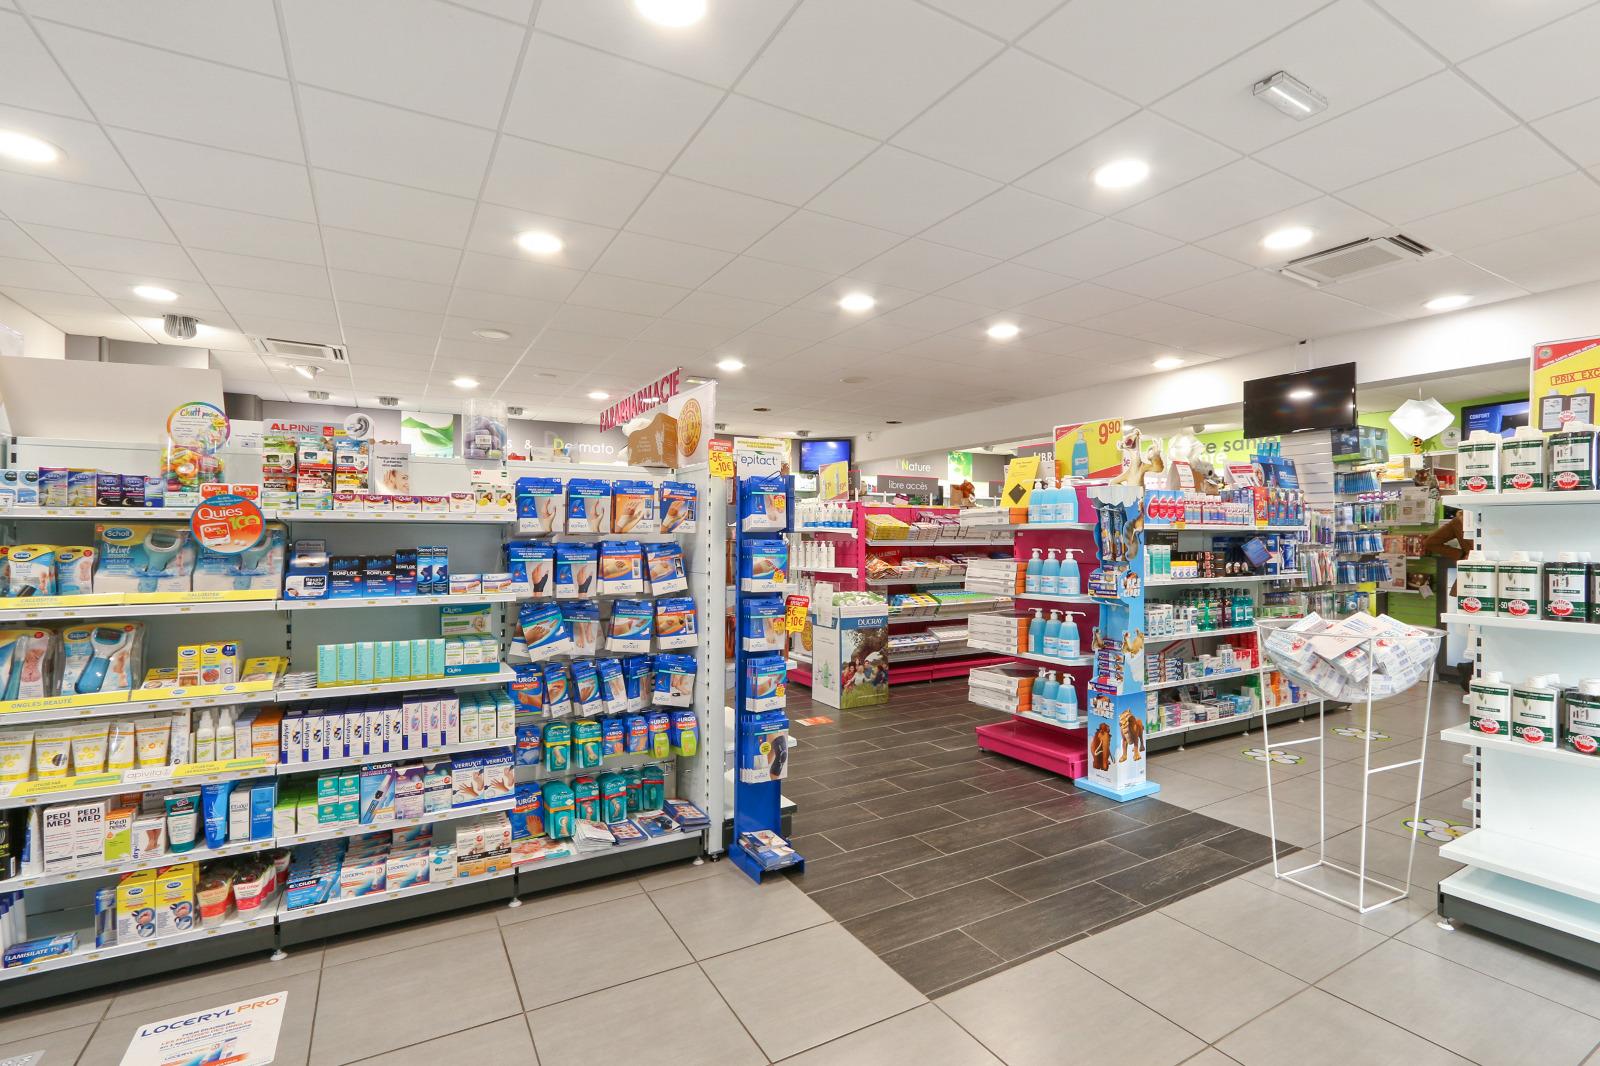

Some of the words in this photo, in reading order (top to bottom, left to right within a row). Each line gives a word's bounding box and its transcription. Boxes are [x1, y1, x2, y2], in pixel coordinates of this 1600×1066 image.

[1554, 372, 1576, 384] PRIX
[271, 422, 318, 432] ALPINE
[710, 452, 722, 462] -5€
[740, 455, 776, 467] epitact
[716, 461, 732, 472] -10€
[901, 459, 932, 472] Nature
[888, 480, 904, 490] libre
[906, 481, 928, 490] accès
[198, 508, 243, 520] Quies
[106, 528, 130, 537] Scholl
[857, 618, 884, 626] DUCRAY
[11, 700, 42, 710] ONGLES
[518, 796, 538, 805] URGO
[46, 812, 70, 820] PEDI
[78, 808, 100, 816] PEDI
[46, 819, 71, 828] MED
[78, 814, 101, 823] MED
[8, 948, 48, 960] LAMISILATE
